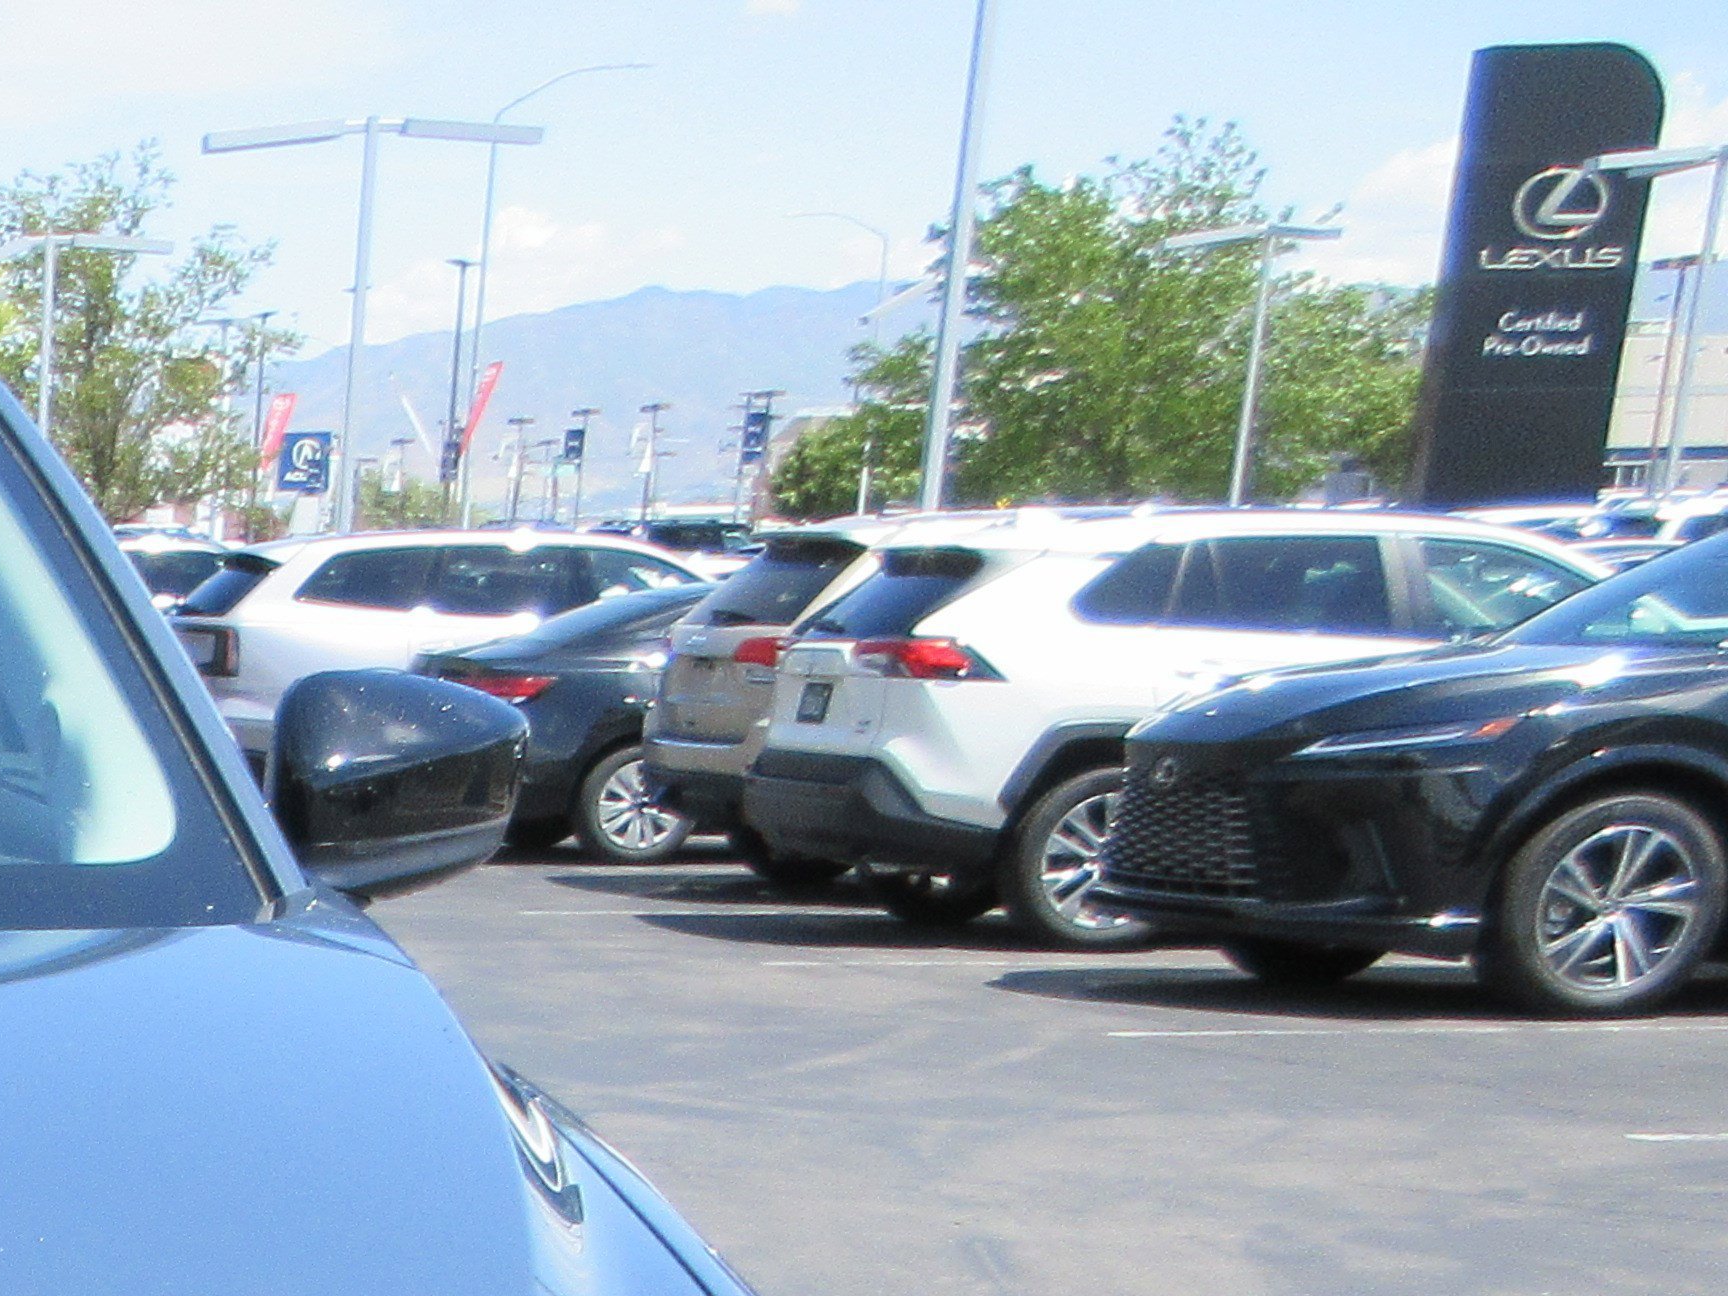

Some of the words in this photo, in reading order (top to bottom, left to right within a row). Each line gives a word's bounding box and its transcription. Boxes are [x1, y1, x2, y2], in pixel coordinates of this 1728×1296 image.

[1479, 246, 1623, 270] LEXUS
[1498, 309, 1584, 332] Certified
[1482, 334, 1592, 357] Pre-Owned
